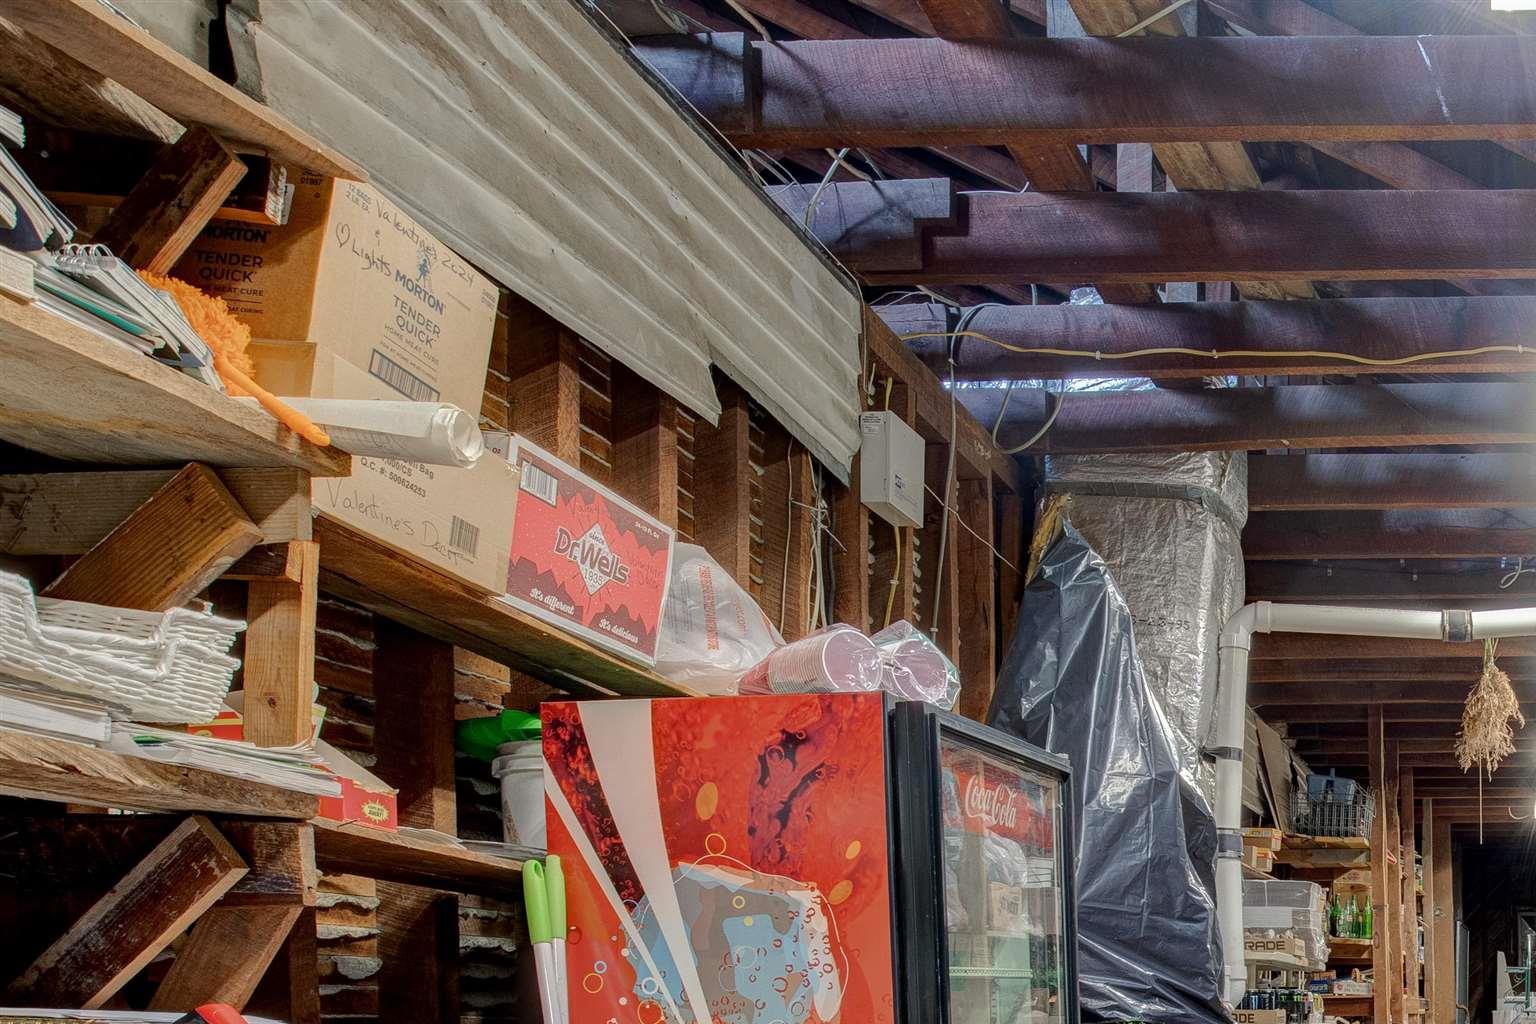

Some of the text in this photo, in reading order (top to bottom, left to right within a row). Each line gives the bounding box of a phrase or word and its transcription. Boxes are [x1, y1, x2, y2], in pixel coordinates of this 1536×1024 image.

[196, 252, 264, 268] TENDER
[351, 237, 391, 277] Lights
[199, 266, 255, 283] QUICK
[240, 287, 264, 297] CURE
[395, 269, 444, 316] MORTON
[393, 294, 441, 338] TENDER
[395, 315, 433, 348] QUICK
[418, 463, 434, 480] Bag
[965, 774, 1017, 830] Coca-Cola
